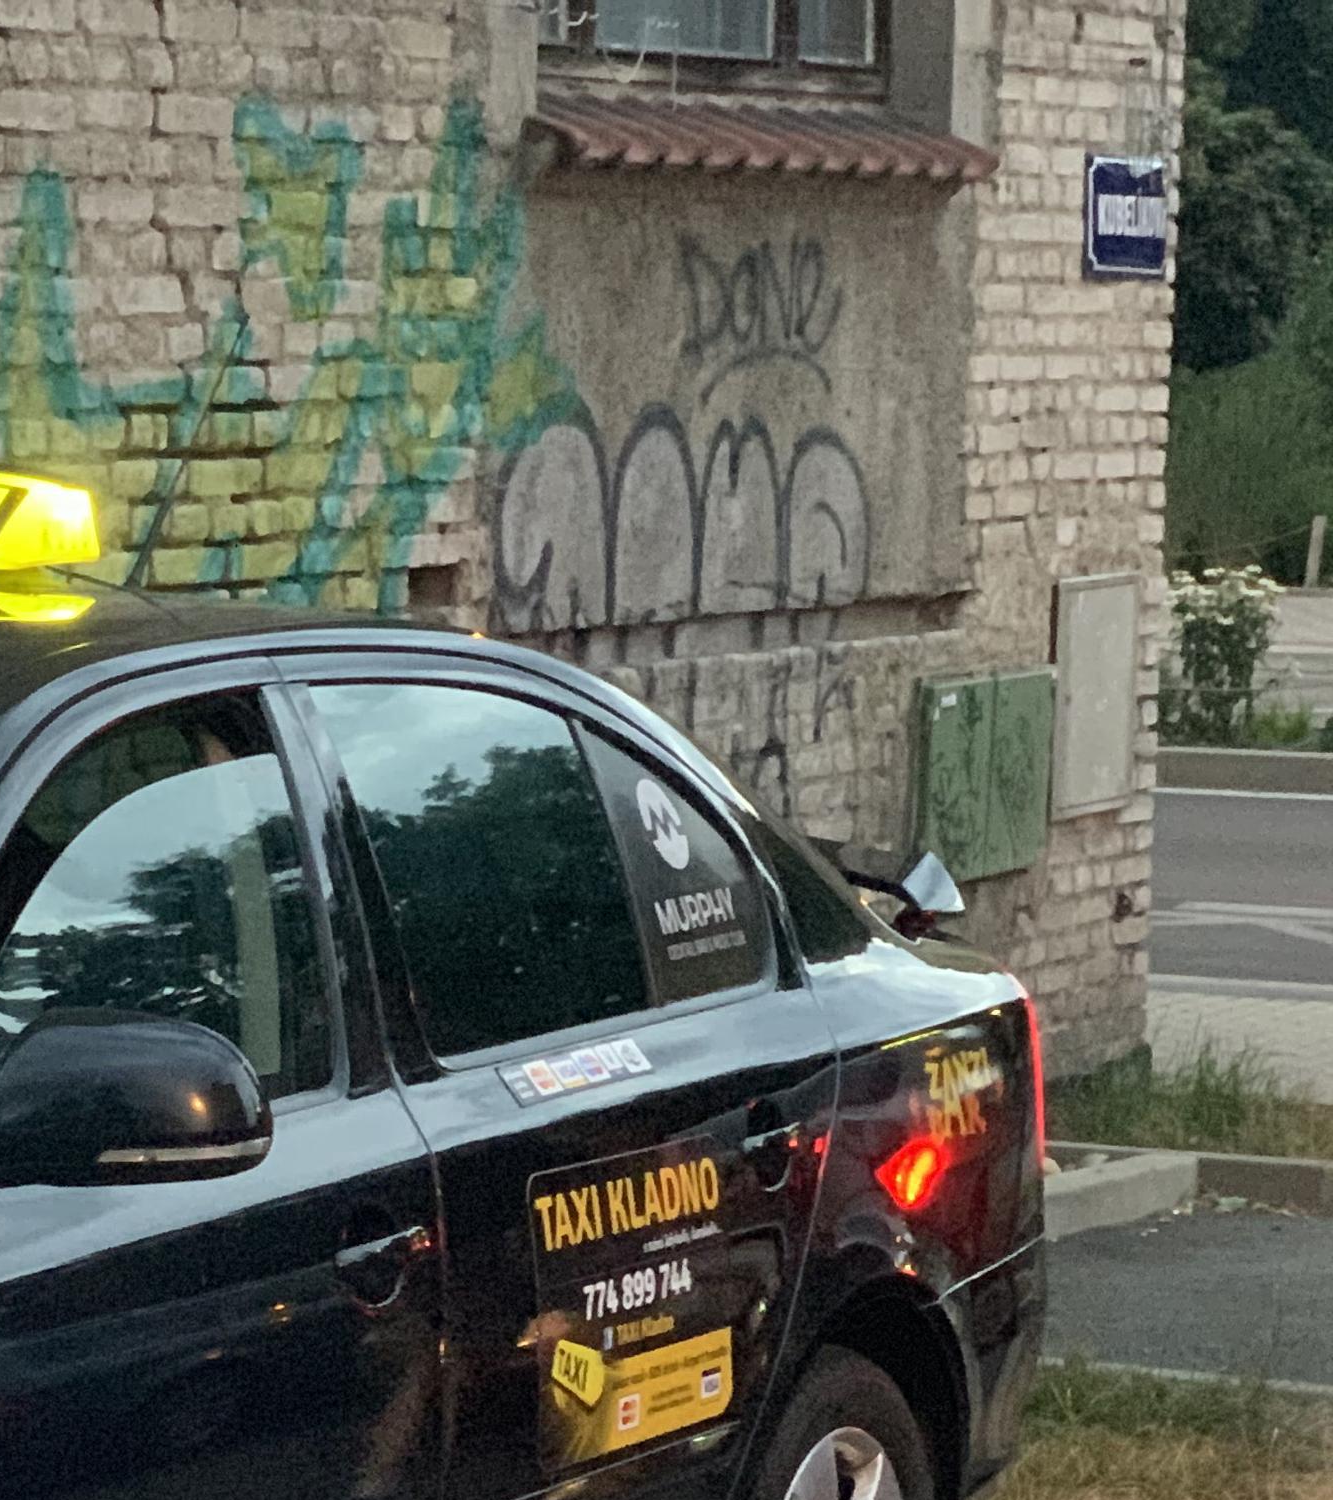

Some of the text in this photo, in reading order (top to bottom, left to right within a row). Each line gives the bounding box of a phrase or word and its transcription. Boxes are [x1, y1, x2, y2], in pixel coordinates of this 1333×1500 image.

[654, 887, 736, 935] MURPHY
[534, 1184, 602, 1252] TAXI
[606, 1157, 720, 1236] KLADNO
[583, 1258, 693, 1321] 774 899 744
[558, 1348, 589, 1393] TAXI
